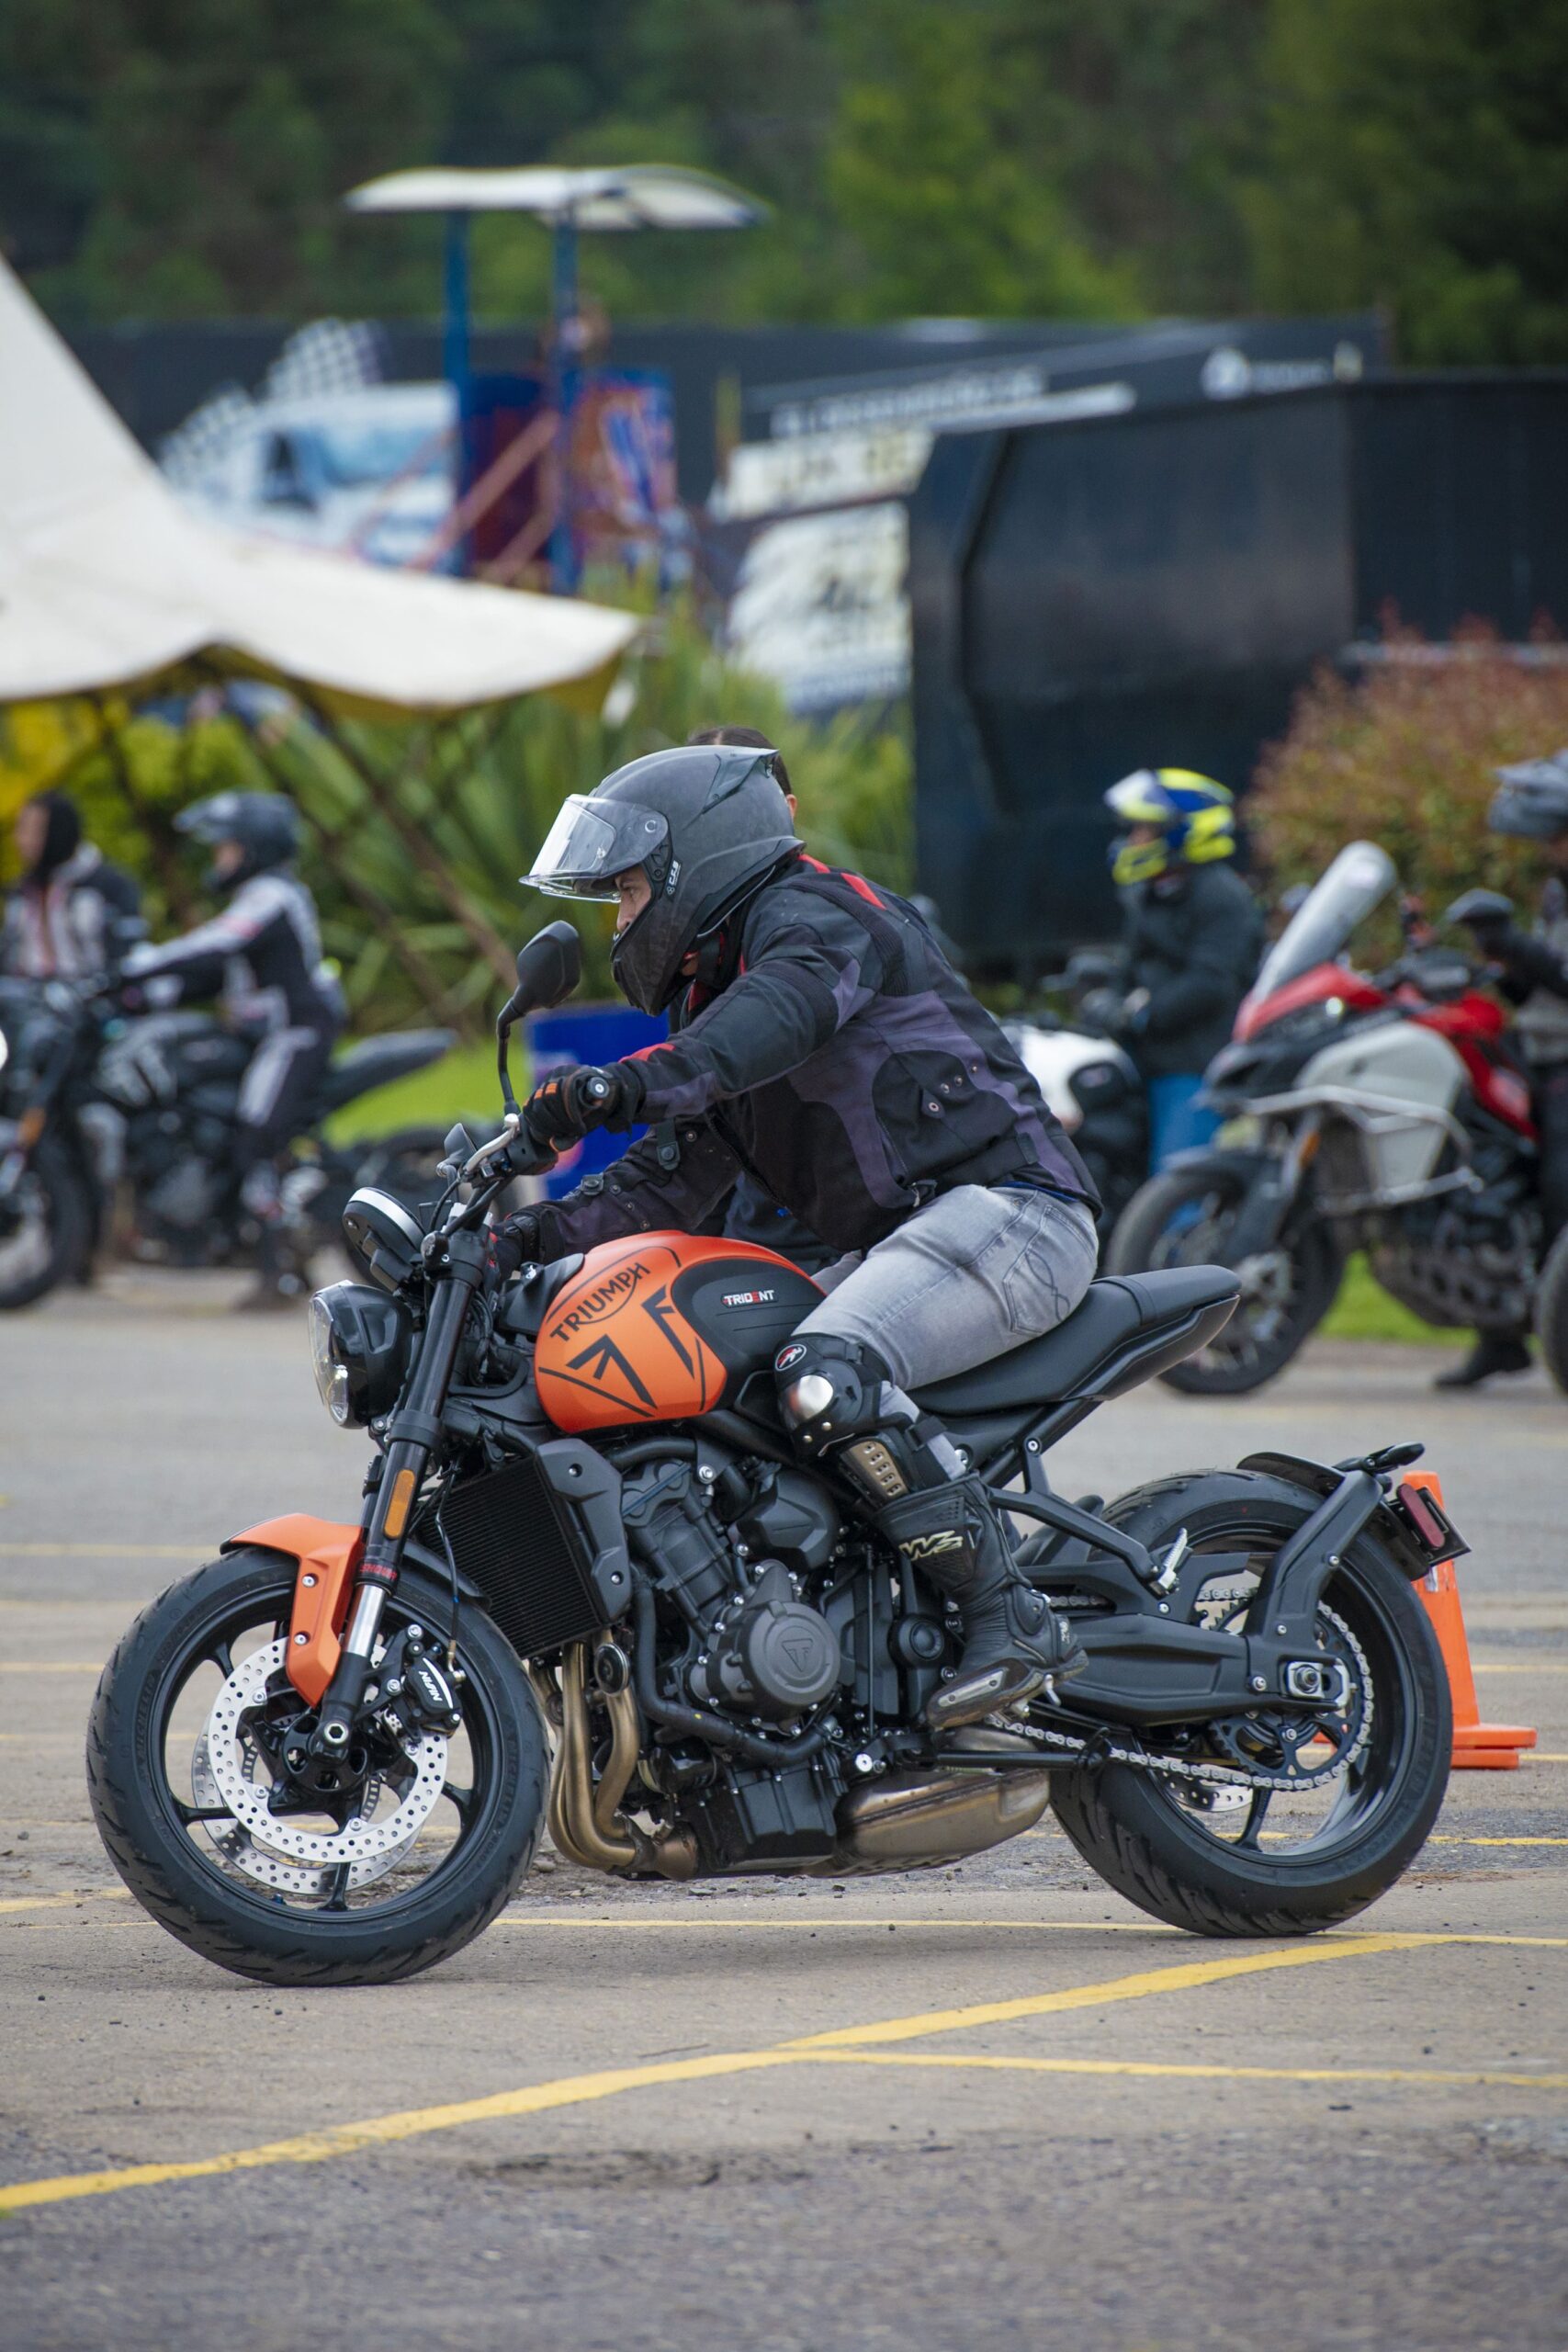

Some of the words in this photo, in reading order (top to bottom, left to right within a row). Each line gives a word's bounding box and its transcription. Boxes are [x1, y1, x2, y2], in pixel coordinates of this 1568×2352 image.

[550, 1262, 650, 1341] TRIUMPH
[723, 1290, 774, 1306] TRIDENT
[418, 1670, 443, 1702] NISSIN
